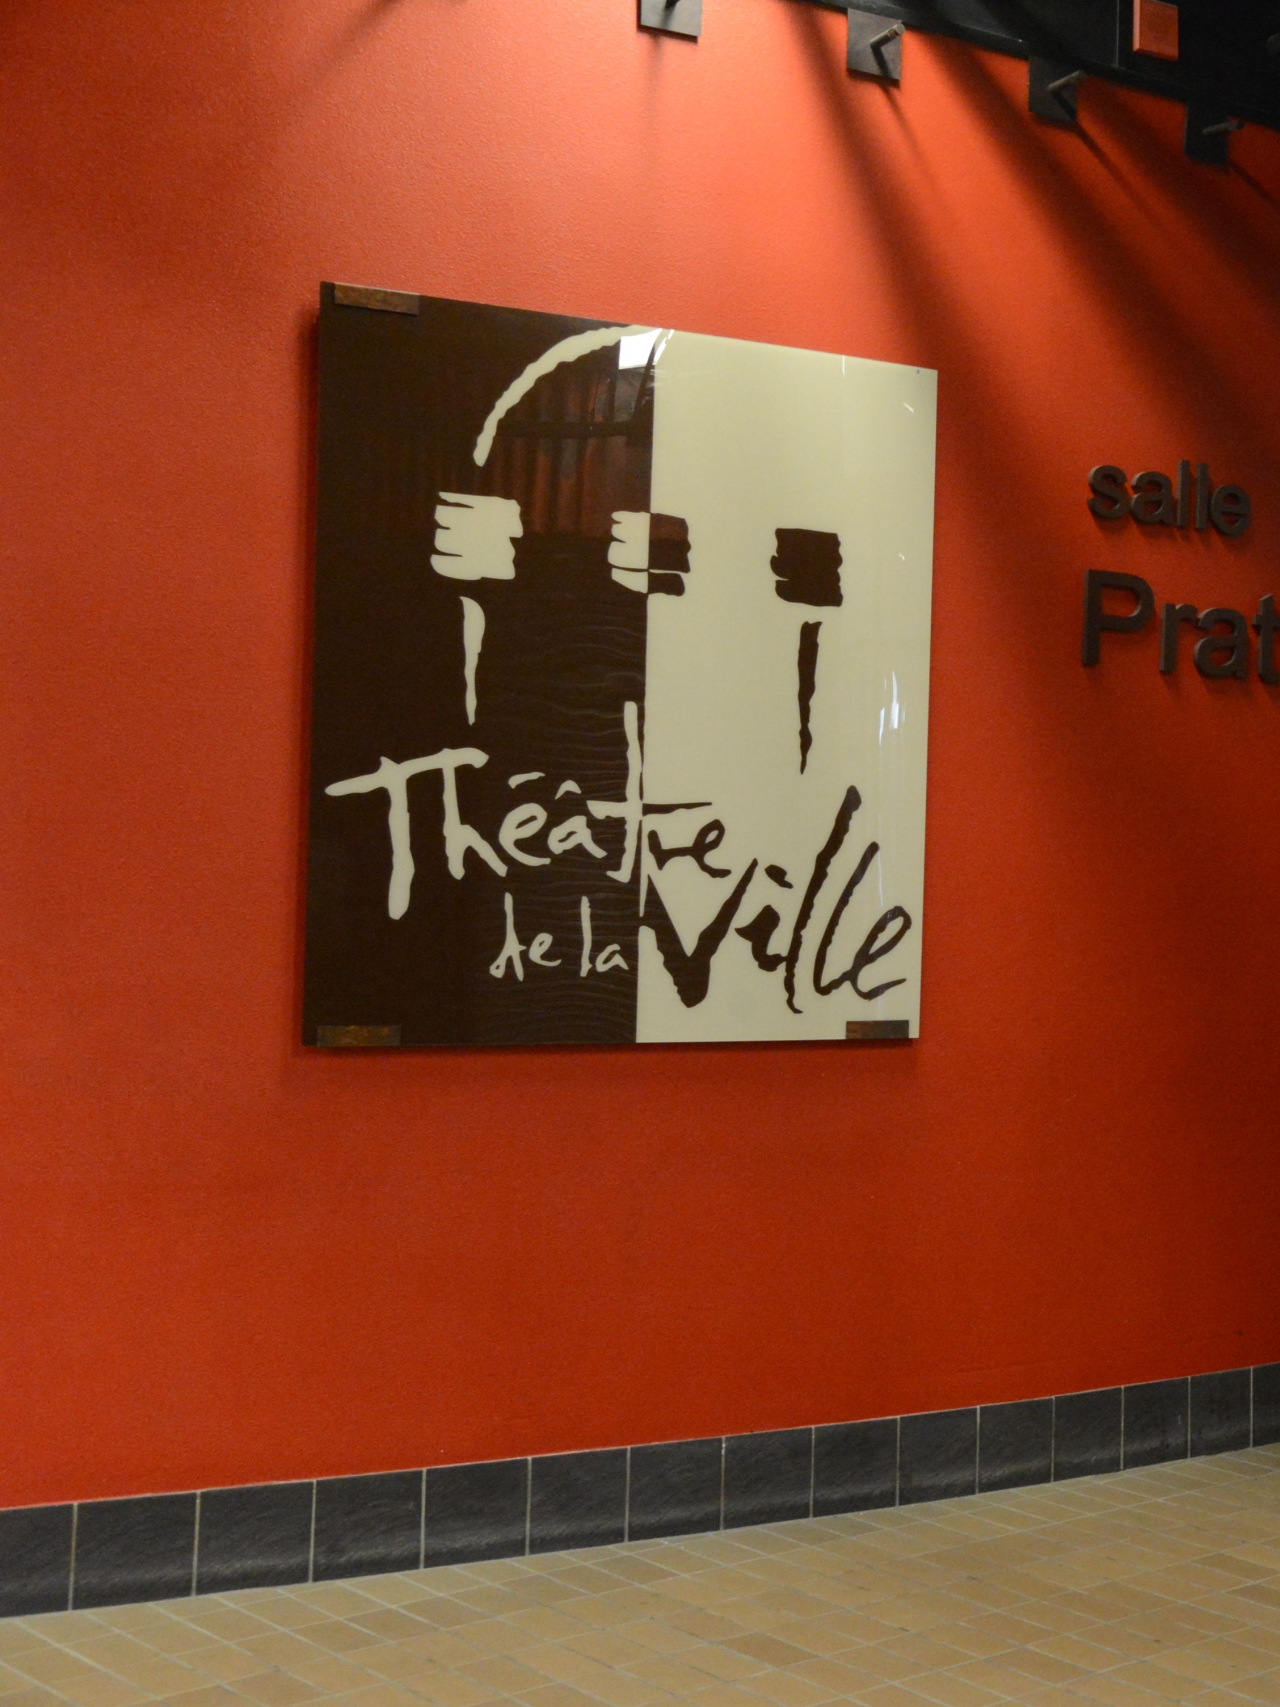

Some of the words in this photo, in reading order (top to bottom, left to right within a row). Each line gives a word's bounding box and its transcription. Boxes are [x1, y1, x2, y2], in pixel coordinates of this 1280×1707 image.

[1087, 459, 1251, 538] salle
[490, 892, 561, 981] de
[581, 895, 629, 978] la
[640, 785, 912, 1015] Ville
